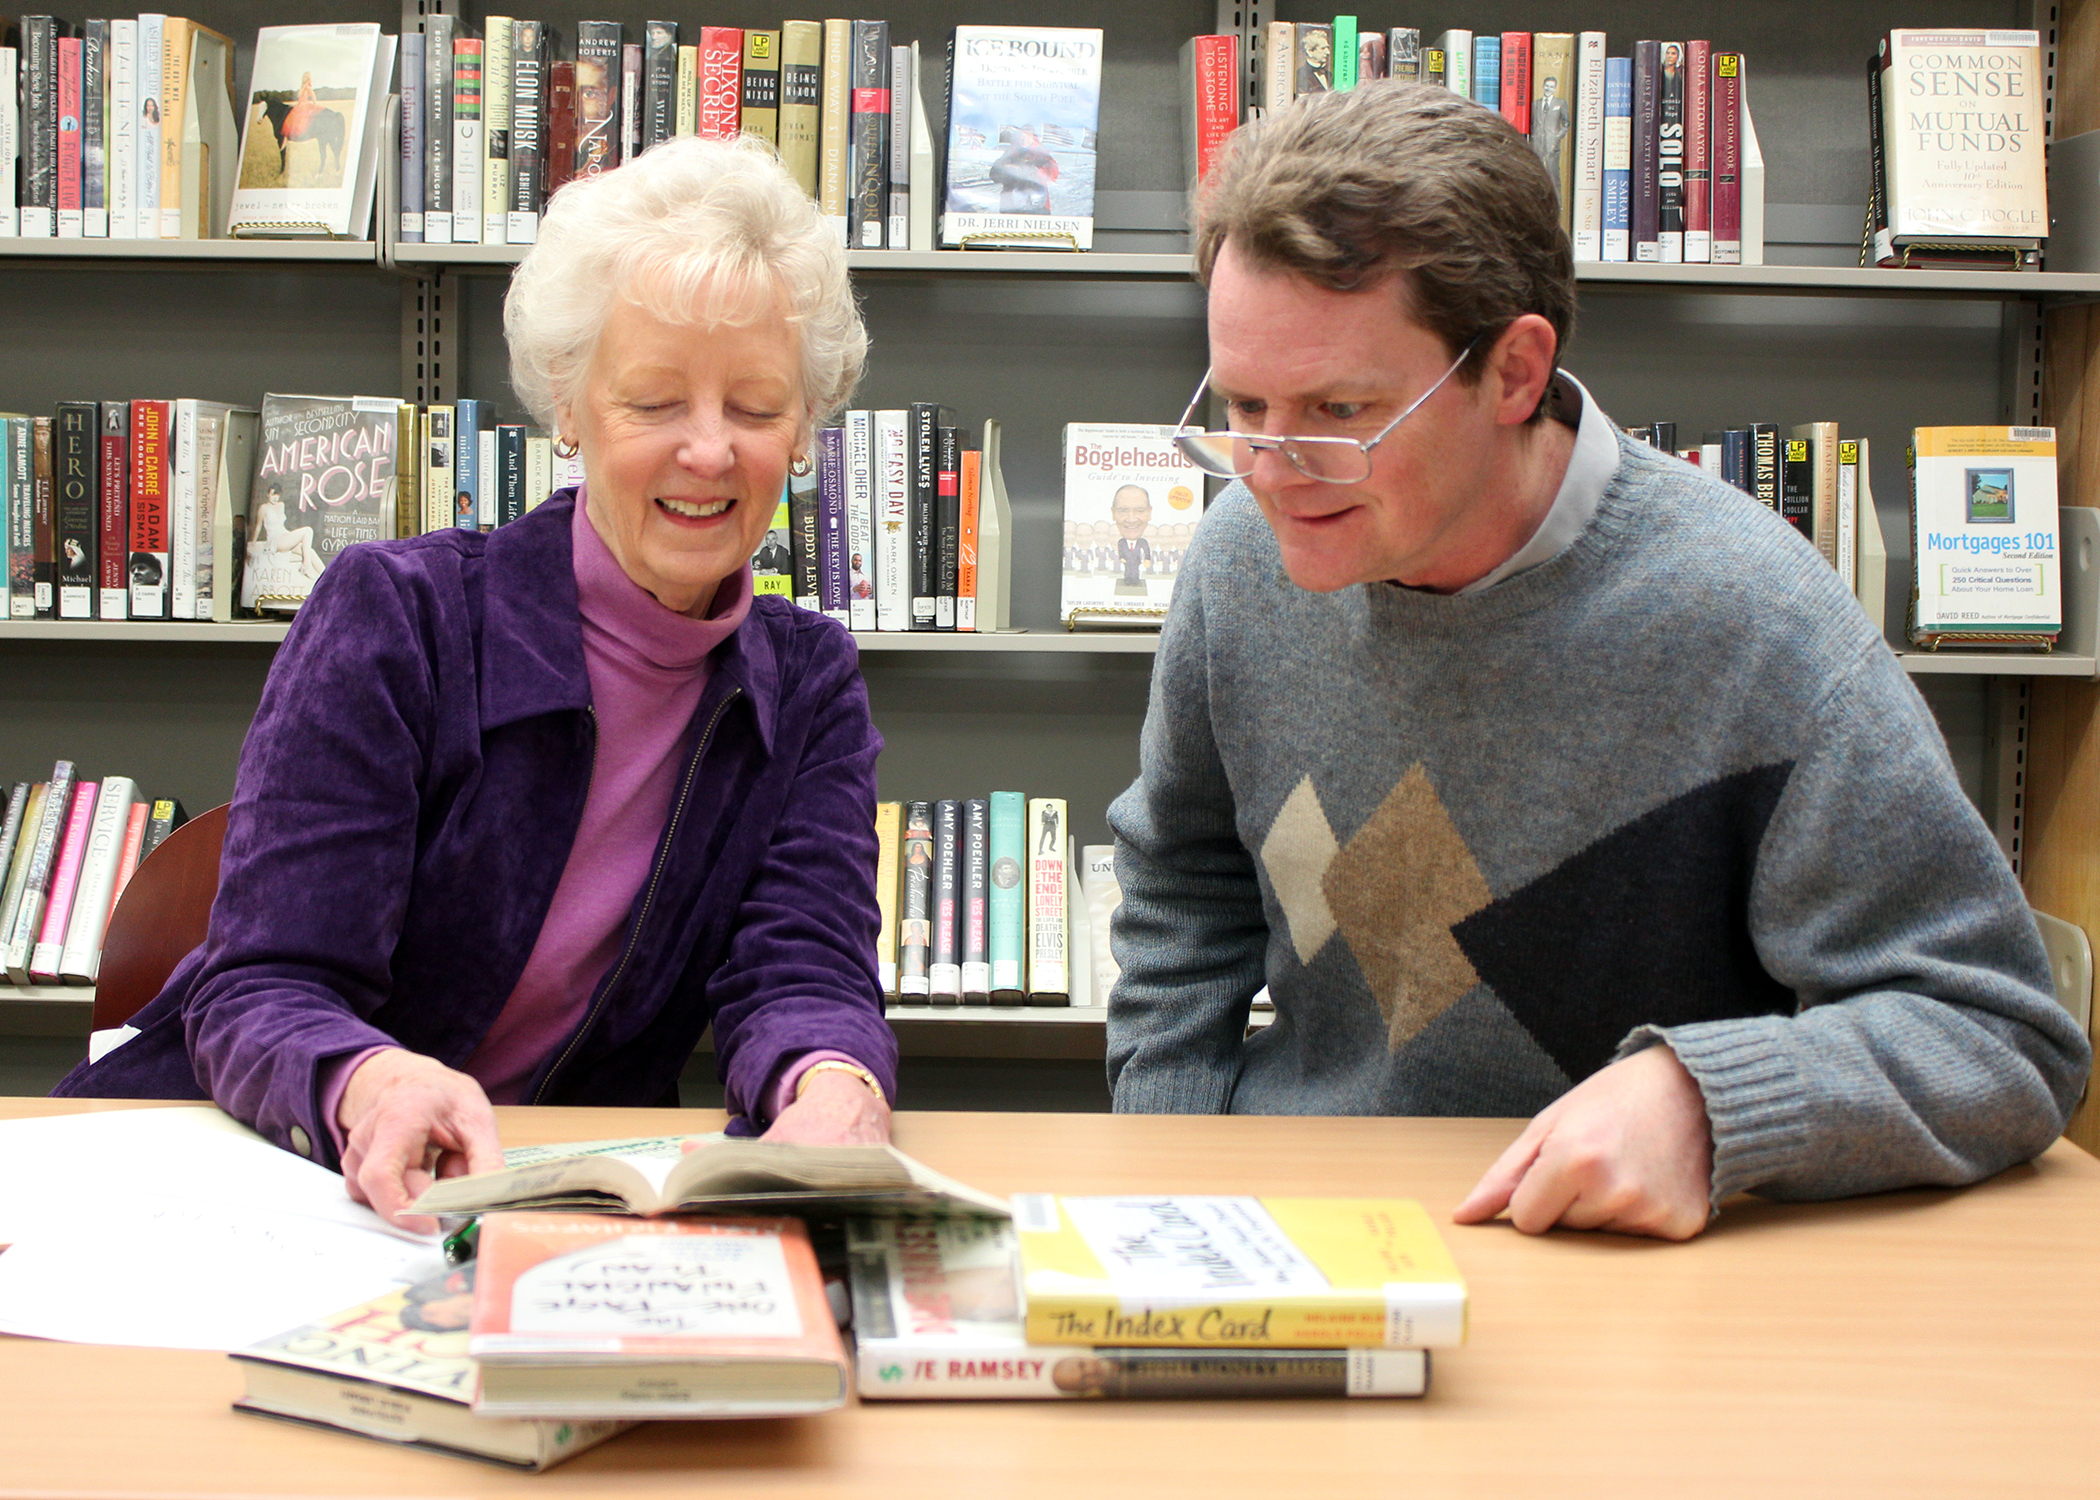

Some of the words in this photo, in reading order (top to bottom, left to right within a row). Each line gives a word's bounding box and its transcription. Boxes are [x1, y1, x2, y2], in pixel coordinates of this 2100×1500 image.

[31, 32, 43, 71] Becoming
[149, 23, 158, 62] ASHLEY
[434, 30, 442, 56] BORN
[579, 38, 617, 46] ANDREW
[579, 48, 618, 57] ROBERTS
[753, 37, 769, 46] LP
[830, 31, 842, 64] FIND
[85, 36, 100, 88] Broken
[1205, 51, 1216, 67] TO
[1696, 50, 1706, 87] SONIA
[1721, 57, 1736, 67] LP
[1908, 54, 2023, 70] COMMON
[31, 72, 43, 93] Steve
[149, 64, 158, 95] JUDD
[434, 60, 442, 85] WITH
[515, 60, 539, 99] ELON
[746, 77, 775, 88] BEING
[786, 72, 816, 84] BEING
[830, 69, 841, 79] A
[1217, 46, 1229, 111] LISTENING
[1275, 42, 1290, 107] AMERICAN
[1517, 47, 1526, 107] UNDERGROUND
[1910, 71, 2024, 98] SENSE
[30, 93, 43, 110] Jobs
[402, 86, 416, 121] John
[720, 50, 739, 140] NIXON'S
[746, 90, 775, 101] NIXON
[786, 86, 816, 98] NIXON
[829, 86, 841, 116] WAY
[1205, 71, 1216, 111] STONE
[1587, 58, 1603, 131] Elizabeth
[434, 89, 442, 120] TEETH
[1959, 100, 1976, 109] ON
[514, 104, 538, 151] MUSK
[1696, 91, 1706, 163] SOTOMAYOR
[1909, 112, 2029, 132] MUTUAL
[402, 125, 416, 162] Muir
[865, 117, 877, 158] QUEEN
[1918, 133, 2021, 153] FUNDS
[1585, 138, 1601, 182] Smart
[1659, 123, 1684, 188] SOLO
[1937, 161, 1962, 172] Fully
[1965, 161, 2008, 172] Updated
[864, 164, 879, 221] NOOR
[1921, 180, 1982, 191] Anniversary
[1986, 181, 2023, 190] Edition
[304, 201, 338, 209] broken
[1605, 179, 1618, 224] SMILEY
[1618, 180, 1629, 223] SARAH
[957, 217, 980, 228] DR.
[982, 218, 1019, 229] JERRI
[1022, 219, 1080, 232] NIELSEN
[137, 407, 146, 427] THE
[146, 407, 161, 440] JOHN
[16, 427, 27, 449] ANNE
[853, 418, 868, 466] MICHAEL
[887, 429, 904, 446] NO
[920, 411, 931, 453] STOLEN
[146, 442, 161, 454] le
[260, 421, 392, 479] AMERICAN
[826, 436, 838, 468] MARIE
[1074, 445, 1196, 472] Bogleheads
[1757, 431, 1774, 481] THOMAS
[1790, 441, 1805, 452] LP
[1841, 443, 1856, 454] LP
[16, 450, 27, 481] LAMOTT
[137, 433, 146, 496] BIOGRAPHY
[201, 454, 211, 475] Back
[507, 450, 518, 470] And
[887, 452, 904, 484] EASY
[920, 456, 932, 489] LIVES
[145, 456, 162, 496] CARRÉ
[201, 477, 211, 485] in
[299, 456, 391, 513] ROSE
[507, 473, 518, 498] Then
[854, 468, 869, 500] OHER
[1088, 472, 1118, 482] Guide
[1120, 473, 1131, 481] to
[1134, 473, 1181, 485] Investing
[22, 484, 32, 519] TRAVELING
[199, 486, 211, 519] Cripple
[827, 470, 839, 515] OSMOND
[888, 491, 905, 517] DAY
[507, 500, 518, 521] Life
[850, 503, 859, 523] THE
[1786, 505, 1808, 514] DOLLAR
[22, 519, 32, 548] MERCIES
[136, 502, 146, 549] SISMAN
[147, 503, 161, 549] ADAM
[201, 520, 211, 546] Creek
[331, 528, 348, 539] LIFE
[355, 527, 378, 538] TIMES
[804, 516, 818, 560] BUDDY
[850, 524, 860, 552] ODDS
[831, 530, 841, 550] THE
[890, 537, 898, 563] MARK
[1927, 532, 2020, 555] Mortgages
[2025, 532, 2056, 550] 101
[831, 551, 841, 570] KEY
[945, 525, 955, 592] FREEDOM
[2002, 552, 2026, 560] Second
[2027, 552, 2054, 560] Edition
[62, 574, 92, 583] Michael
[764, 581, 782, 590] RAY
[806, 566, 818, 597] LEVY
[831, 571, 841, 580] IS
[890, 566, 898, 596] OWEN
[1952, 576, 1967, 584] 250
[1968, 576, 1994, 584] Critical
[1994, 576, 2033, 585] Questions
[831, 582, 842, 605] LOVE
[1951, 585, 1973, 593] About
[1974, 585, 1991, 593] Your
[1993, 585, 2014, 593] Home
[2015, 585, 2034, 593] Loan
[90, 783, 123, 859] SERVICE
[943, 803, 955, 829] AMY
[972, 803, 983, 829] AMY
[942, 834, 954, 890] POEHLER
[971, 834, 983, 889] POEHLER
[1035, 860, 1063, 871] DOWN
[1035, 883, 1057, 895] END
[1041, 872, 1063, 883] THE
[908, 867, 930, 919] Pocahontas
[1035, 895, 1063, 907] LONELY
[942, 900, 953, 917] YES
[971, 899, 982, 916] YES
[1034, 907, 1063, 917] STREET
[941, 920, 953, 955] PLEASE
[970, 920, 982, 953] PLEASE
[1035, 923, 1057, 932] DEATH
[1035, 933, 1063, 949] ELVIS
[1034, 949, 1063, 960] PRESLEY
[1050, 1310, 1095, 1338] The
[1103, 1307, 1186, 1341] Index
[1195, 1305, 1275, 1342] Card
[948, 1359, 1045, 1380] RAMSEY
